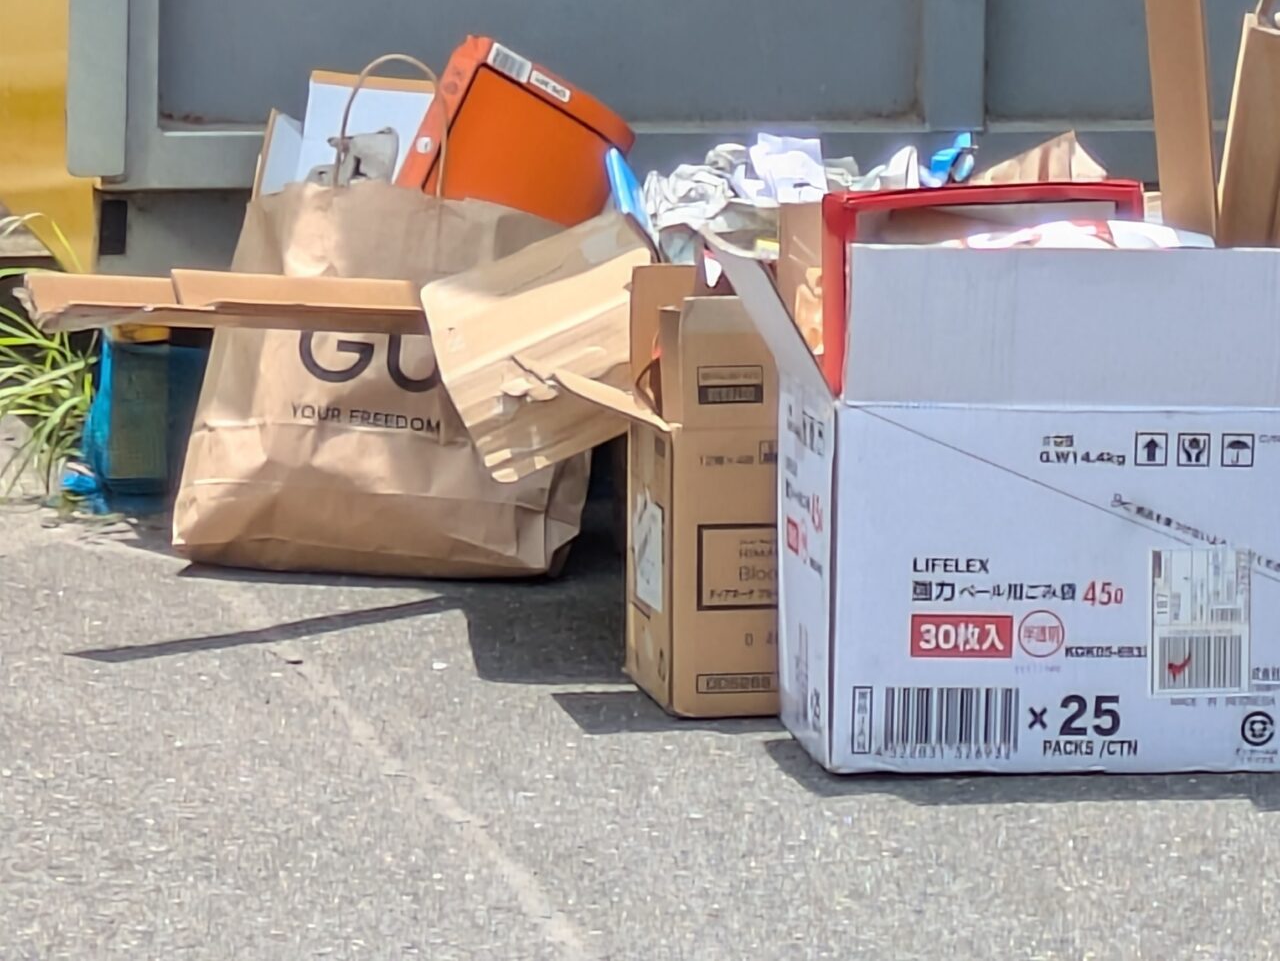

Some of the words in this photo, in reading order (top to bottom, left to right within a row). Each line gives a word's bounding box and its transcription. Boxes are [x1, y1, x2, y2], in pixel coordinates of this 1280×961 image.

[291, 401, 341, 424] YOUR
[349, 409, 441, 434] FREEDOM
[912, 557, 990, 575] LIFELEX
[918, 622, 1005, 652] 30枚入
[1059, 694, 1121, 737] 25
[1043, 740, 1094, 756] PACKS
